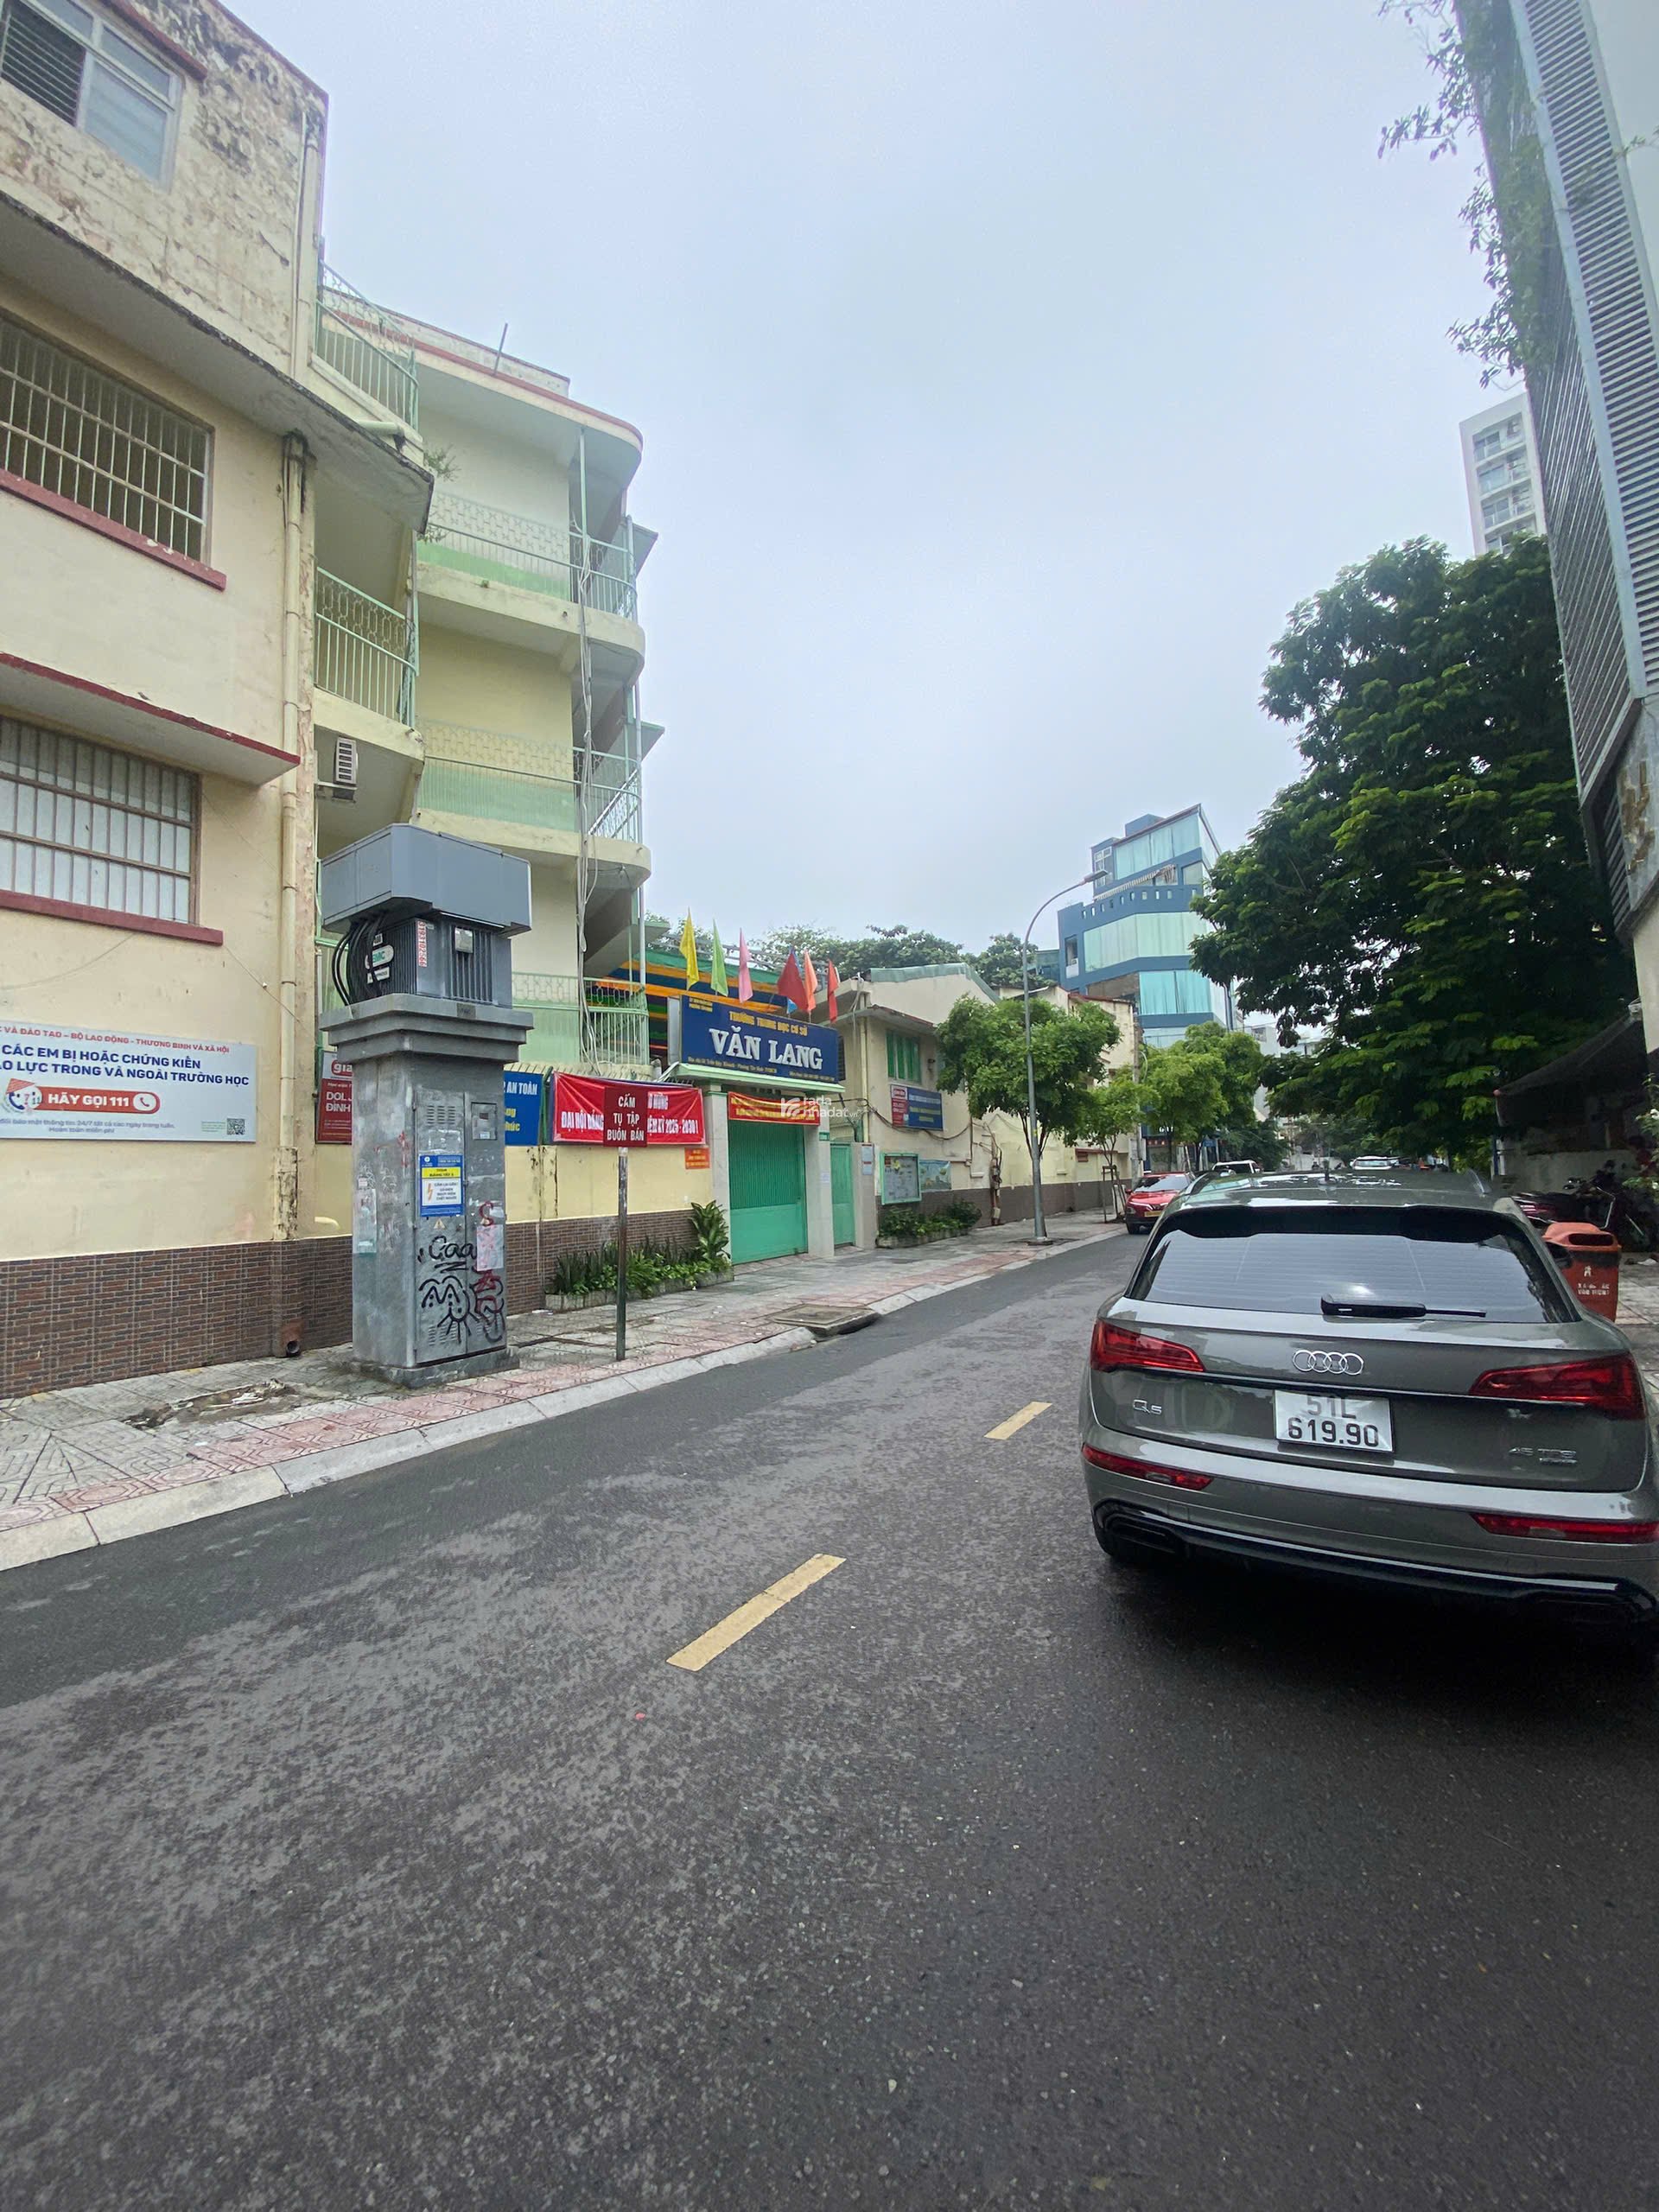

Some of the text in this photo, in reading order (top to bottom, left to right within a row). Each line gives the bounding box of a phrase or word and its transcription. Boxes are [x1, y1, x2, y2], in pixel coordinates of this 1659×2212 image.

[217, 1046, 230, 1054] HỘI
[709, 1025, 761, 1060] VĂN
[768, 1039, 823, 1070] LANG
[2, 1043, 200, 1069] CÁC EM BỊ HOẶC CHỨNG KIẾN
[17, 1061, 48, 1074] LỰC
[52, 1064, 101, 1076] TRONG
[104, 1065, 123, 1077] VÀ
[127, 1069, 168, 1080] NGOÀI
[170, 1071, 222, 1084] TRƯỜNG
[226, 1076, 249, 1087] HỌC
[326, 1091, 347, 1101] DOL
[506, 1081, 517, 1094] AN
[519, 1081, 537, 1095] TOÀN
[48, 1092, 129, 1108] HÃY GỌI 111
[619, 1092, 636, 1108] CẤM
[562, 1111, 575, 1132] ĐẠI
[575, 1109, 587, 1133] HỘI
[588, 1109, 604, 1131] ĐẢNG
[613, 1111, 639, 1127] TỤ TẬP
[607, 1128, 645, 1141] BUÔN BÁN
[1132, 1399, 1162, 1416] Q5
[1306, 1393, 1357, 1419] 51L
[1287, 1417, 1379, 1448] 619.90
